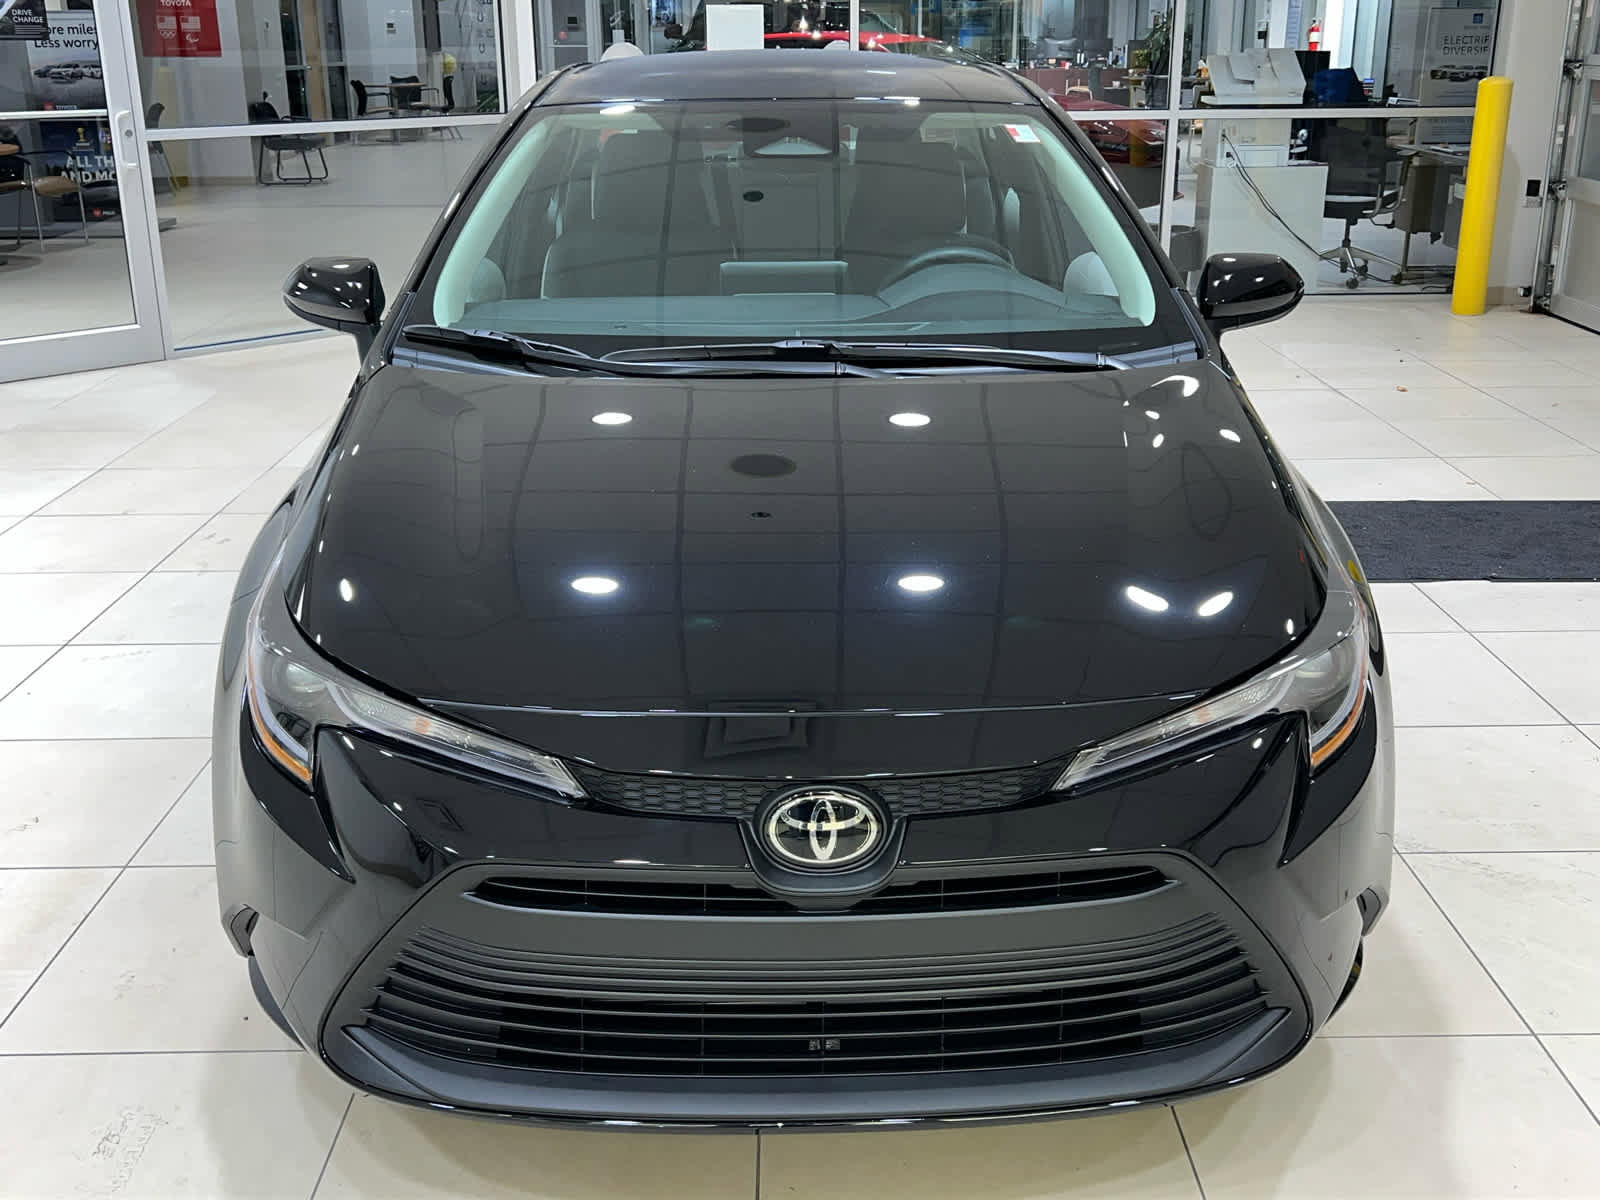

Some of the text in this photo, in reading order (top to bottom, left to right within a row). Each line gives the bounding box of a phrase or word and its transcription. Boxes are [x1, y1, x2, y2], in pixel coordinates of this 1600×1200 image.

[34, 39, 98, 50] Less worry
[1443, 35, 1490, 45] ELECTRIF
[1442, 46, 1489, 56] DIVERSIF
[94, 155, 114, 168] TH
